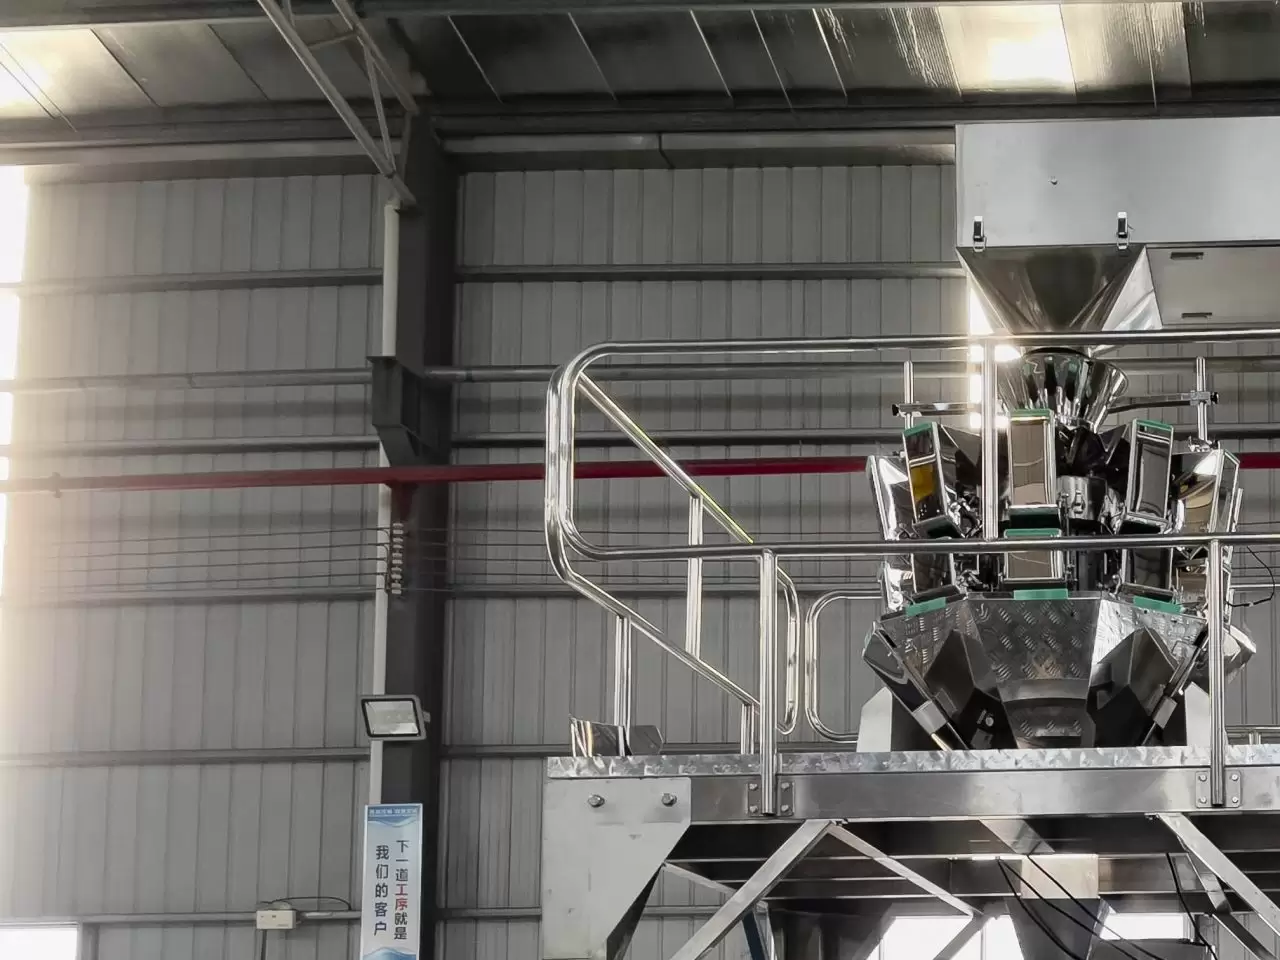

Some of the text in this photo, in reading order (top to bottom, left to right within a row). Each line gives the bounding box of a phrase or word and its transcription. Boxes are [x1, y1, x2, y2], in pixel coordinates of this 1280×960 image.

[374, 845, 389, 936] 我们的客户
[394, 840, 409, 940] 下一道工序就是
